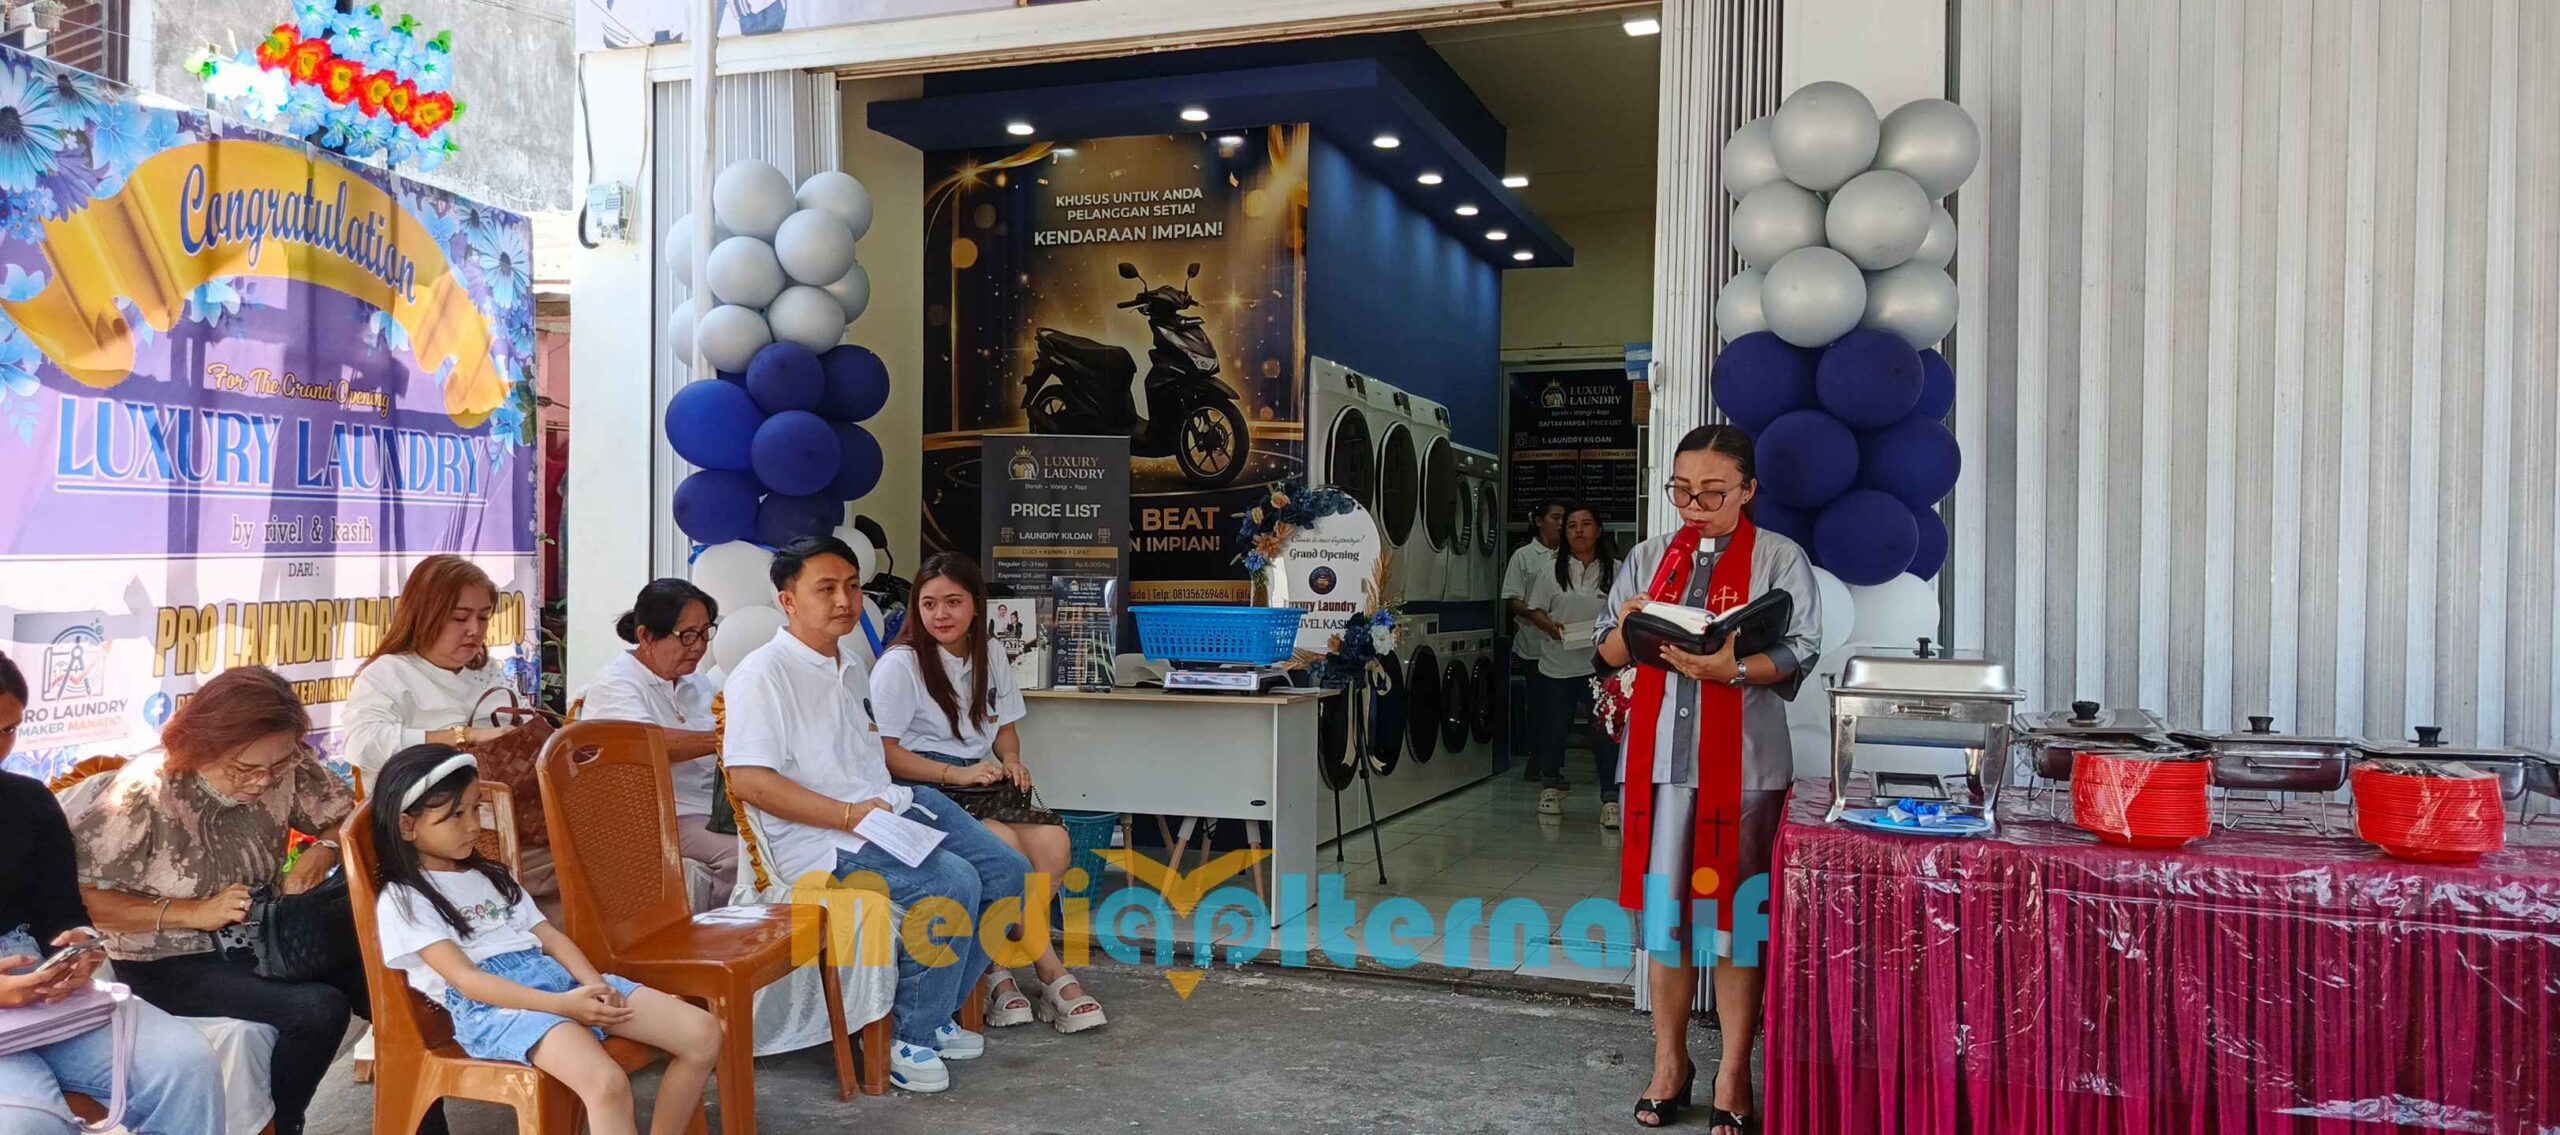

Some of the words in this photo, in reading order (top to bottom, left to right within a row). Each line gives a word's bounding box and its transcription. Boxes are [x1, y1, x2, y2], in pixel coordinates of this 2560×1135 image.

[1056, 193, 1110, 207] KHUSUS
[1113, 190, 1160, 204] UNTUK
[1163, 187, 1203, 201] ANDA
[1067, 206, 1150, 221] PELANGGAN
[1153, 203, 1196, 217] SETIA!
[181, 164, 416, 303] Congratulation
[1034, 226, 1147, 246] KENDARAAN
[1152, 221, 1223, 240] IMPIAN!
[206, 363, 247, 391] For
[250, 368, 280, 394] The
[281, 373, 335, 401] Grand
[336, 379, 391, 419] Opening
[1570, 385, 1617, 396] LUXURY
[1570, 395, 1622, 406] LAUNDRY
[57, 394, 282, 487] LUXURY
[296, 417, 487, 497] LAUNDRY
[1584, 436, 1612, 444] KILOAN
[1044, 456, 1099, 467] LUXURY
[1044, 468, 1105, 479] LAUNDRY
[1011, 503, 1061, 517] PRICE
[1065, 503, 1101, 518] LIST
[1142, 507, 1220, 531] BEAT
[231, 515, 254, 548] by
[265, 515, 302, 543] rivel
[311, 516, 322, 542] &
[331, 516, 373, 543] kasih
[1019, 532, 1060, 540] LAUNDRY
[1061, 532, 1092, 541] KILOAN
[1147, 536, 1220, 552] IMPIAN!
[1289, 548, 1318, 560] Grand
[1319, 549, 1360, 562] Opening
[288, 562, 314, 577] DARI
[1285, 600, 1315, 612] uxury
[1318, 600, 1357, 613] Laundry
[1299, 619, 1322, 629] IVEL
[1323, 619, 1348, 629] KASI
[153, 605, 219, 678] PRO
[224, 597, 349, 670] LAUNDRY
[23, 708, 49, 723] RO
[53, 699, 129, 720] LAUNDRY
[19, 722, 65, 738] MAKER
[68, 715, 122, 731] MANADO
